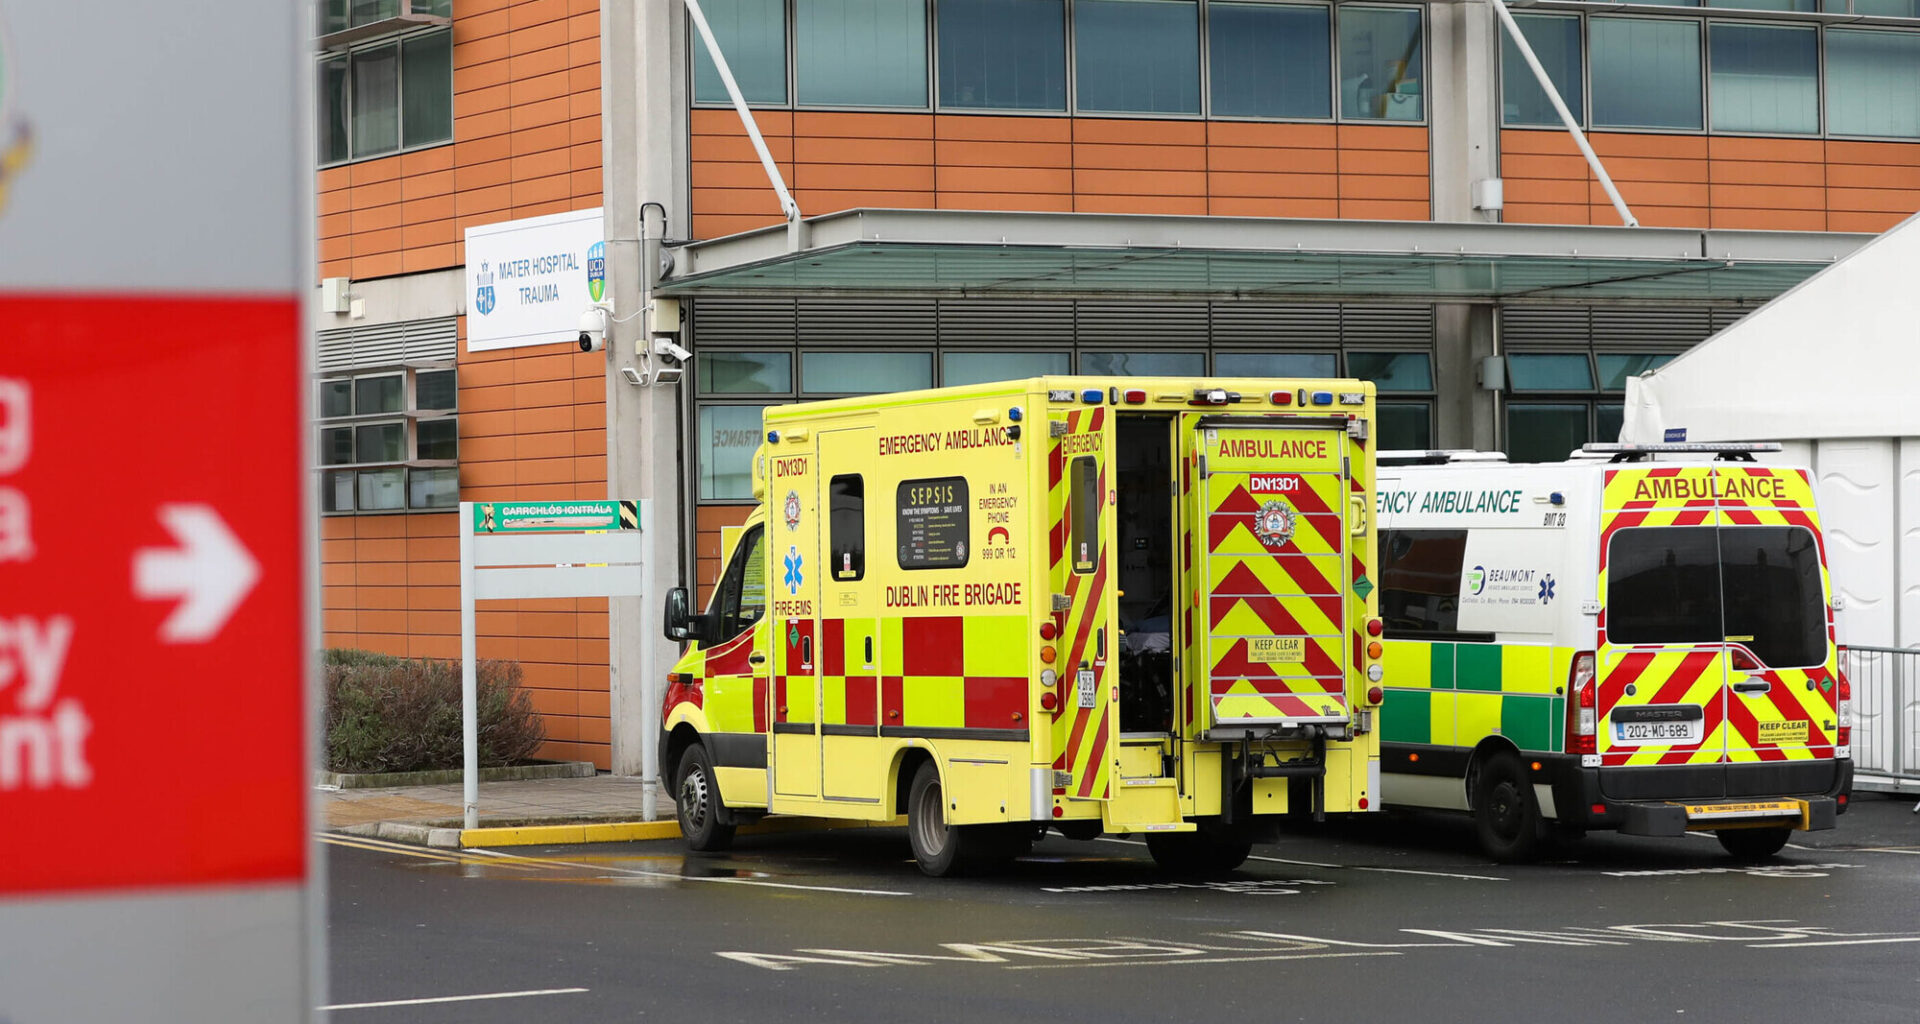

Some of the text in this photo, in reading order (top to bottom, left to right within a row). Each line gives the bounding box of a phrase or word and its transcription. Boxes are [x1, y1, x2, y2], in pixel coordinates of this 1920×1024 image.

[499, 252, 579, 279] MATER HOSPITAL
[589, 259, 604, 271] UCD
[519, 283, 560, 305] TRAUMA
[879, 432, 942, 455] EMERGENCY
[1062, 432, 1104, 455] EMERGENCY
[1218, 439, 1327, 459] AMBULANCE
[776, 457, 808, 478] DN13D1
[990, 482, 1007, 494] IN AN
[1250, 476, 1300, 492] DN13D1
[1634, 476, 1786, 501] AMBULANCE
[910, 485, 953, 506] SEPSIS
[979, 496, 1018, 510] EMERGENCY
[1420, 490, 1523, 513] AMBULANCE
[988, 511, 1009, 523] PHONE
[982, 548, 993, 559] 999
[995, 547, 1004, 559] OR
[1489, 569, 1535, 582] BEAUMONT
[886, 582, 1022, 608] DUBLIN FIRE BRIGADE
[1254, 639, 1299, 650] KEEP CLEAR
[1635, 710, 1683, 718] MASTER
[1628, 724, 1689, 738] 202-MO-689
[1760, 721, 1807, 730] KEEP CLEAR
